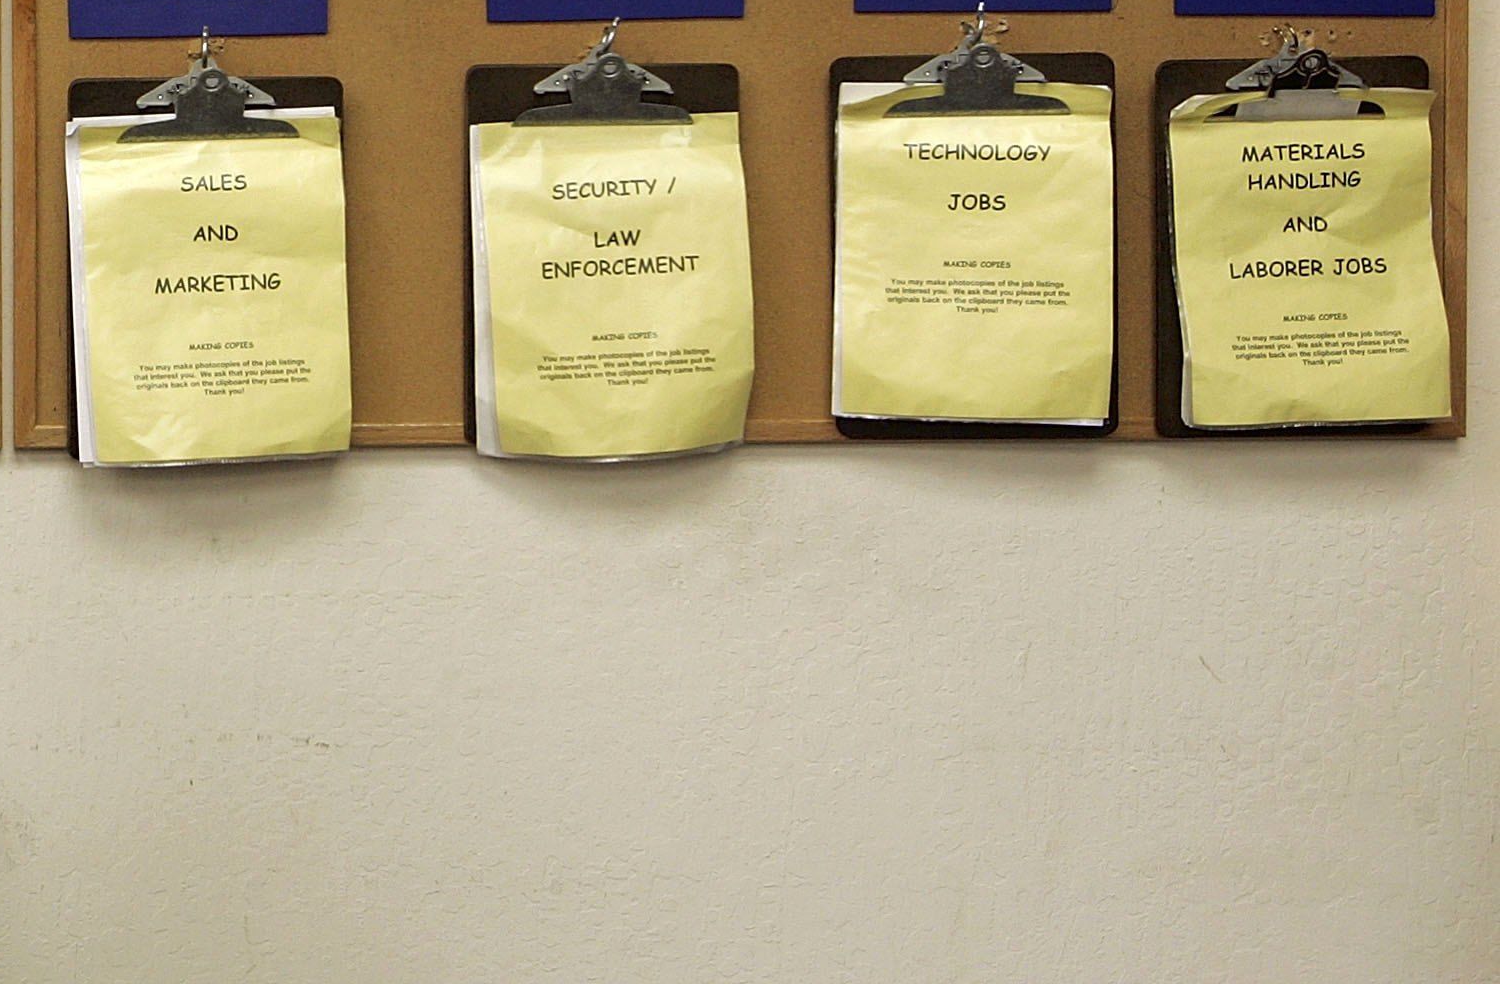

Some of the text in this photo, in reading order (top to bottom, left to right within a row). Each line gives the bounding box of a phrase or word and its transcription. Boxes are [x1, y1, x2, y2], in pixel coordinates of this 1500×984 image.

[903, 143, 1050, 161] TECHNOLOGY
[1242, 143, 1365, 162] MATERIALS
[180, 173, 247, 192] SALES
[551, 178, 656, 200] SECURITY
[1248, 170, 1361, 190] HANDLING
[947, 193, 1006, 211] JOBS
[193, 224, 238, 241] AND
[1282, 215, 1327, 232] AND
[594, 229, 640, 248] LAW
[541, 255, 699, 279] ENFORCEMENT
[943, 260, 1011, 268] MAKING COPIES
[1229, 257, 1387, 279] LABORER JOBS
[155, 272, 281, 294] MARKETING
[947, 279, 995, 288] photocopies
[1007, 279, 1020, 287] the
[1021, 280, 1034, 288] job
[1035, 280, 1064, 289] listings
[591, 331, 657, 341] MAKING COPIES
